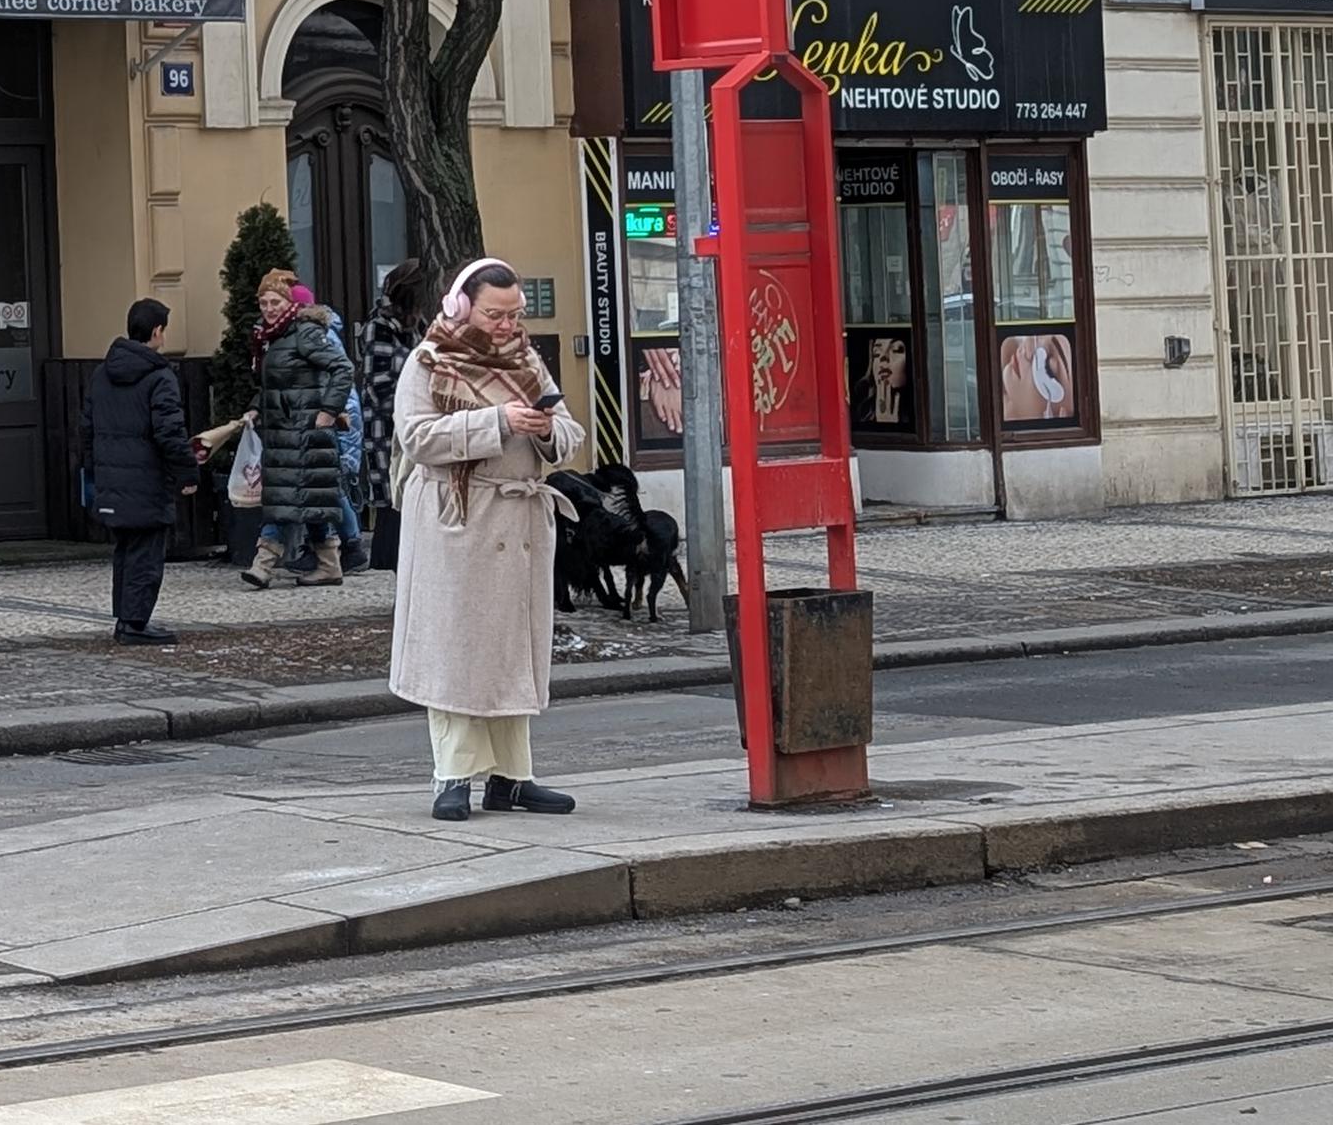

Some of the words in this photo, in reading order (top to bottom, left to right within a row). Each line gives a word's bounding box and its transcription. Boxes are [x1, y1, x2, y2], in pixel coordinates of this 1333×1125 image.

[169, 69, 189, 88] 96
[841, 82, 929, 109] NEHTOVÉ
[933, 88, 1000, 110] STUDIO
[1016, 103, 1038, 119] 773
[1040, 103, 1062, 119] 264
[1065, 103, 1087, 119] 447
[836, 163, 900, 181] NEHTOVÉ
[991, 167, 1028, 186] OBOČÍ
[1035, 167, 1064, 186] ŘASY
[843, 182, 895, 196] STUDIO
[595, 231, 609, 294] BEAUTY
[597, 297, 611, 355] STUDIO
